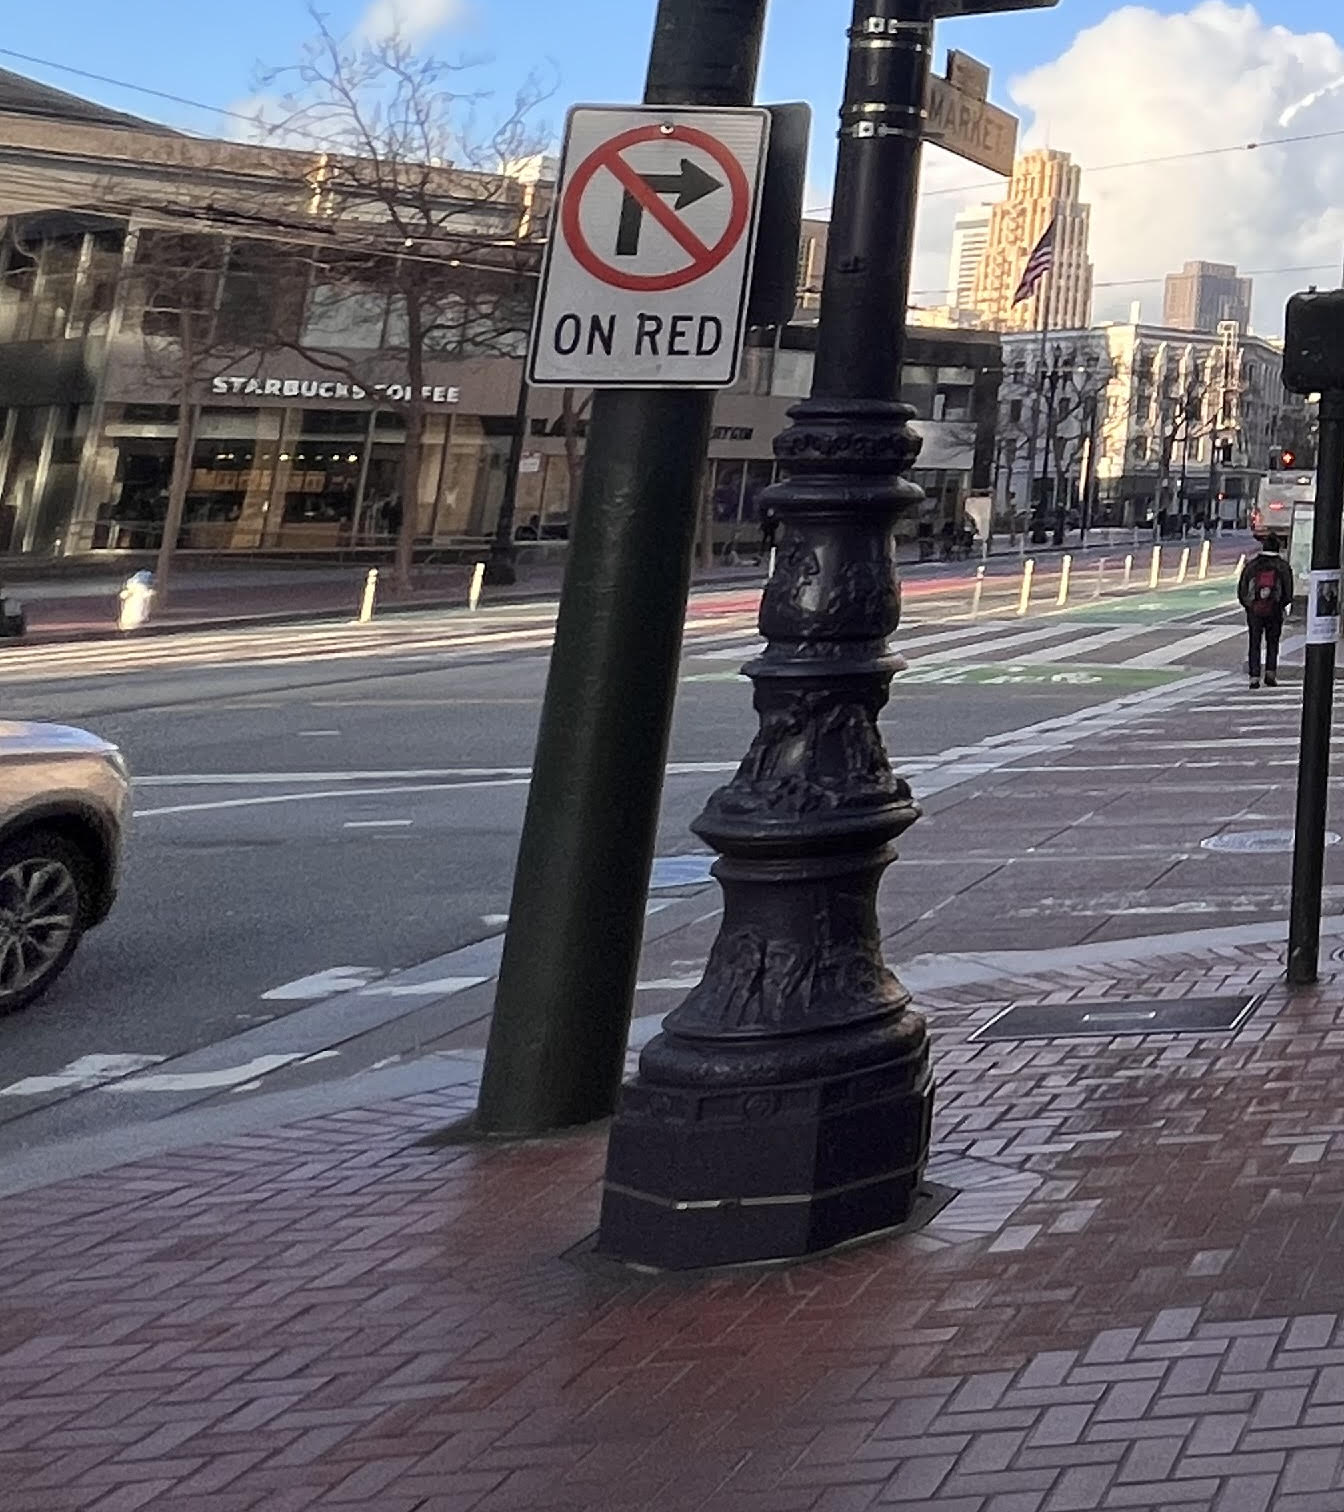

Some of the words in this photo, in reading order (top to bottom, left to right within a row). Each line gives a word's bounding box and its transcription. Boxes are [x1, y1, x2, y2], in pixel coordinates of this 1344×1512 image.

[928, 88, 1006, 154] MARKET
[554, 313, 617, 355] ON
[634, 312, 722, 356] RED
[212, 377, 366, 399] STARBUCKS
